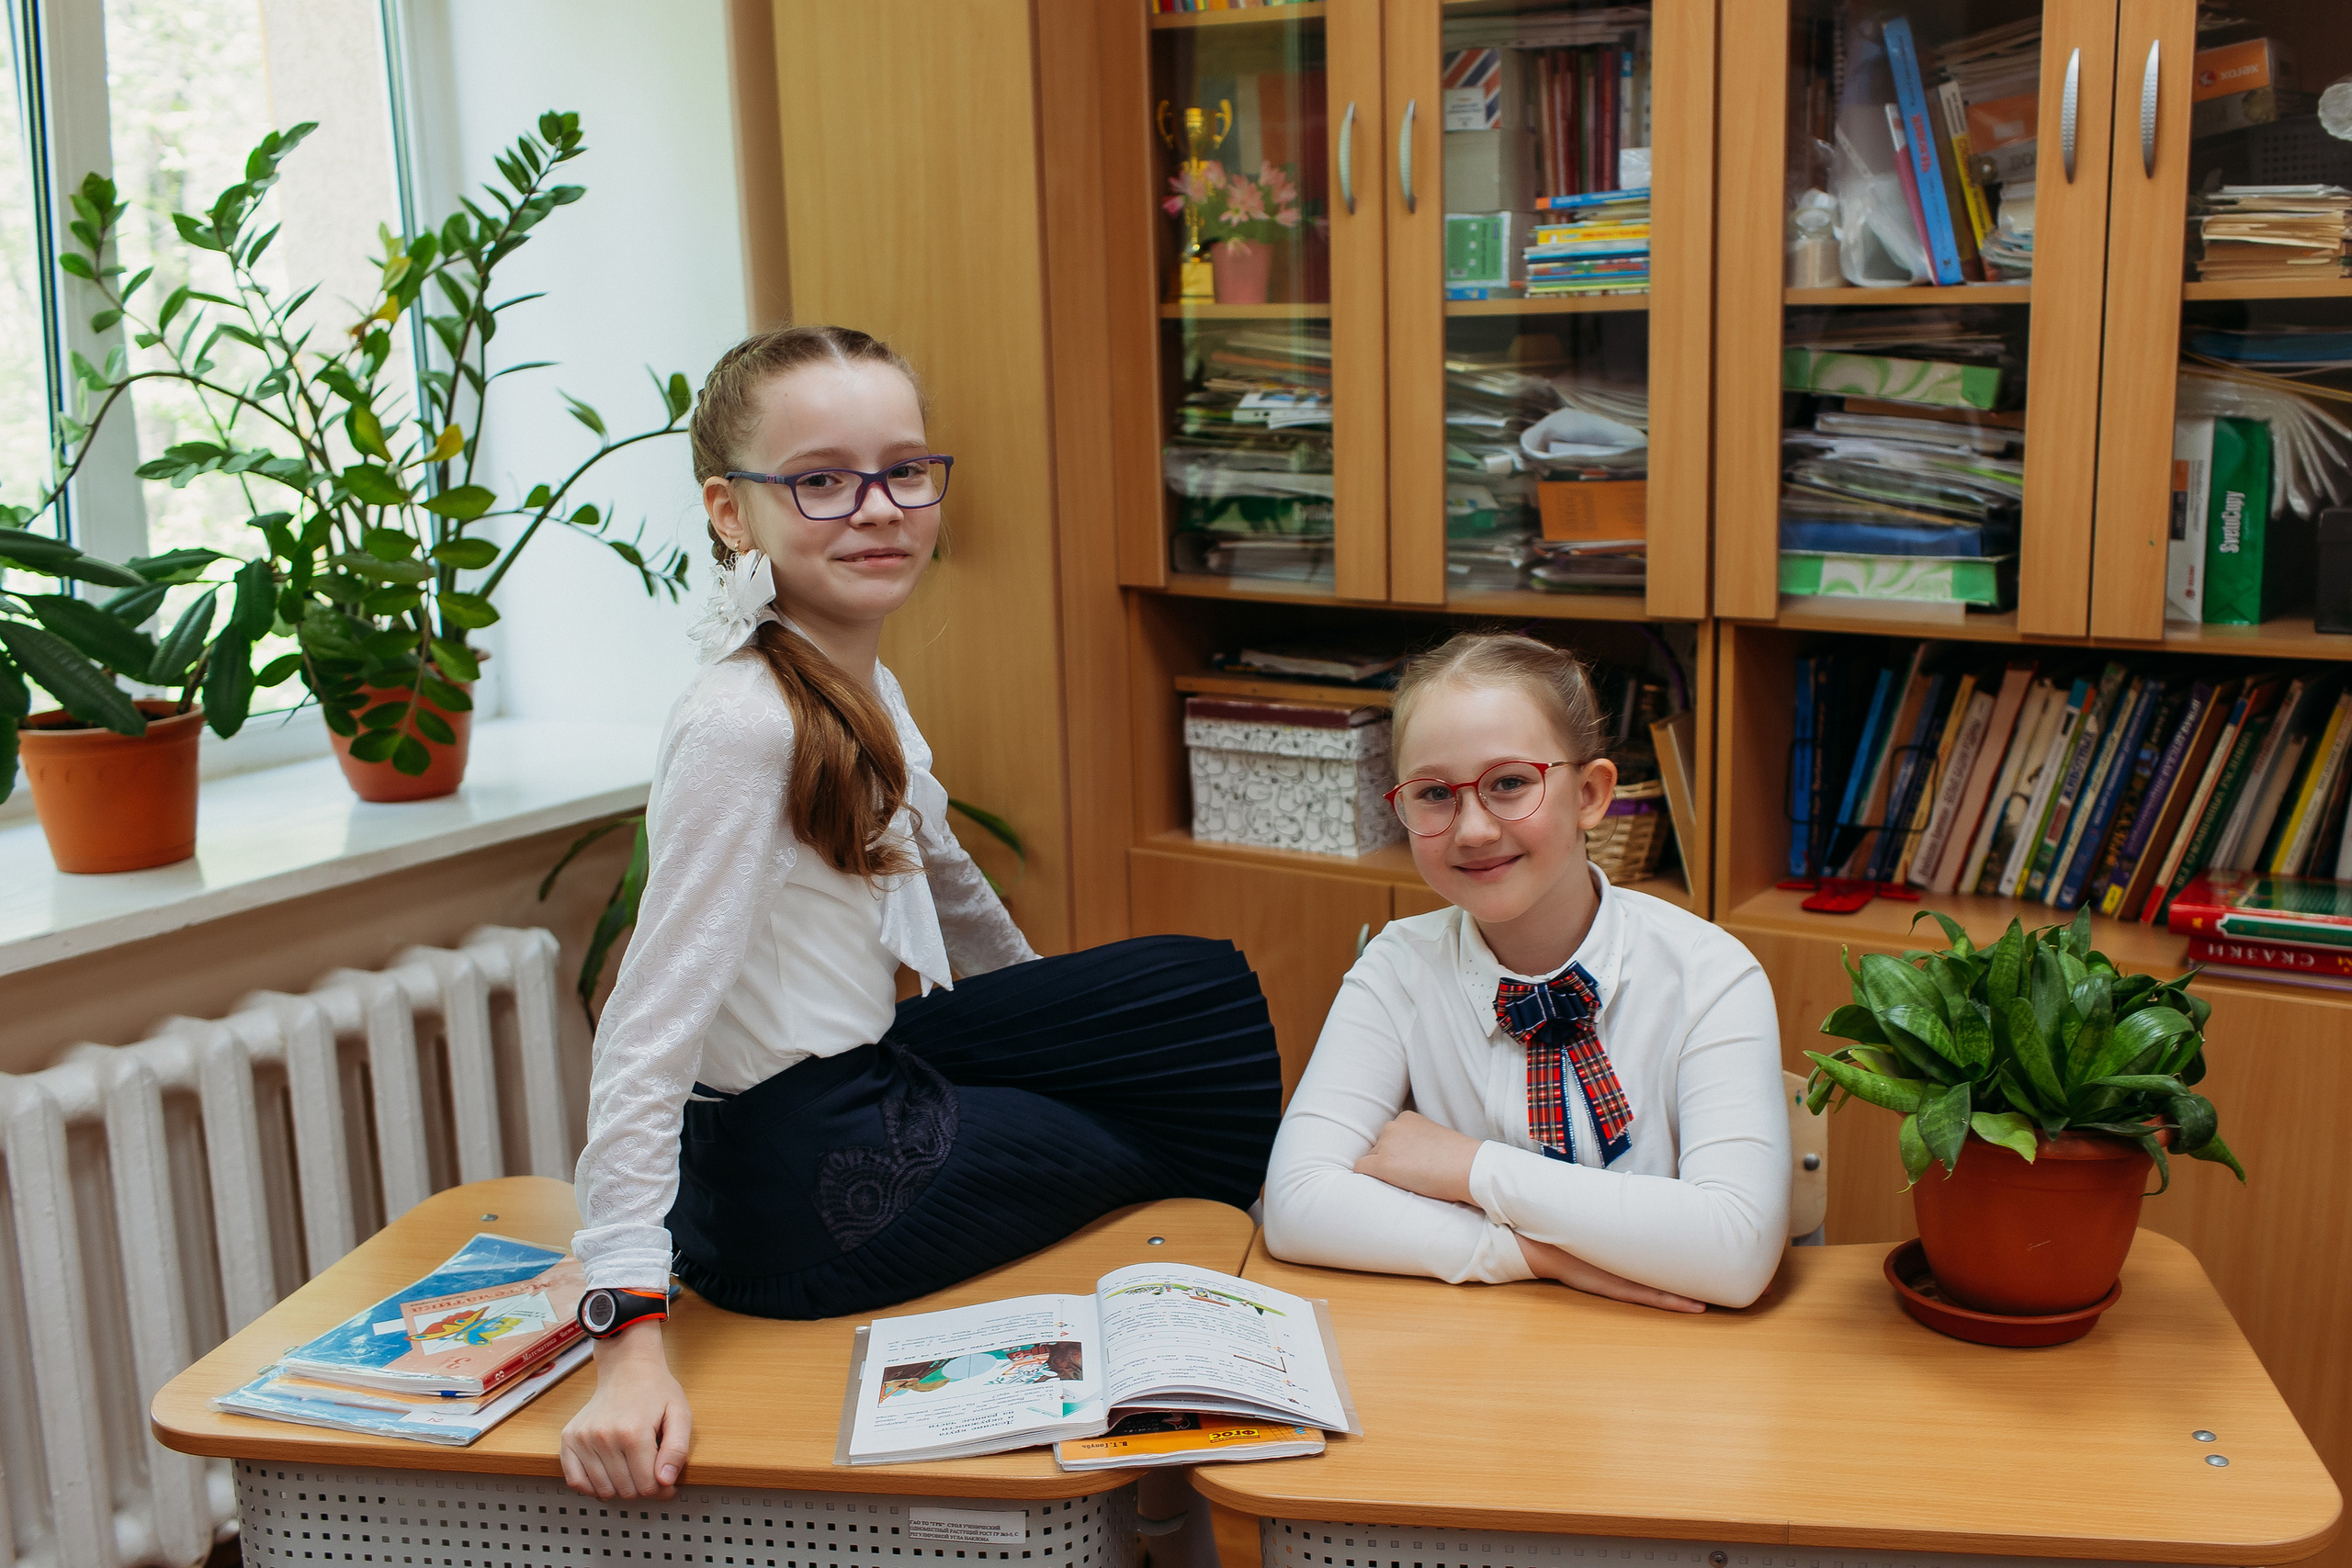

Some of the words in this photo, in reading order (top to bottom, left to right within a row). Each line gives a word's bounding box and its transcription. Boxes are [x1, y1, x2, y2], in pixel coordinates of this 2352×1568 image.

[2220, 490, 2246, 553] SvetoCopy
[2207, 942, 2314, 966] СКАЗКИ
[410, 1282, 551, 1313] Математика
[522, 1337, 557, 1360] Математика
[495, 1370, 504, 1381] 3
[1212, 1429, 1256, 1439] ФГОС
